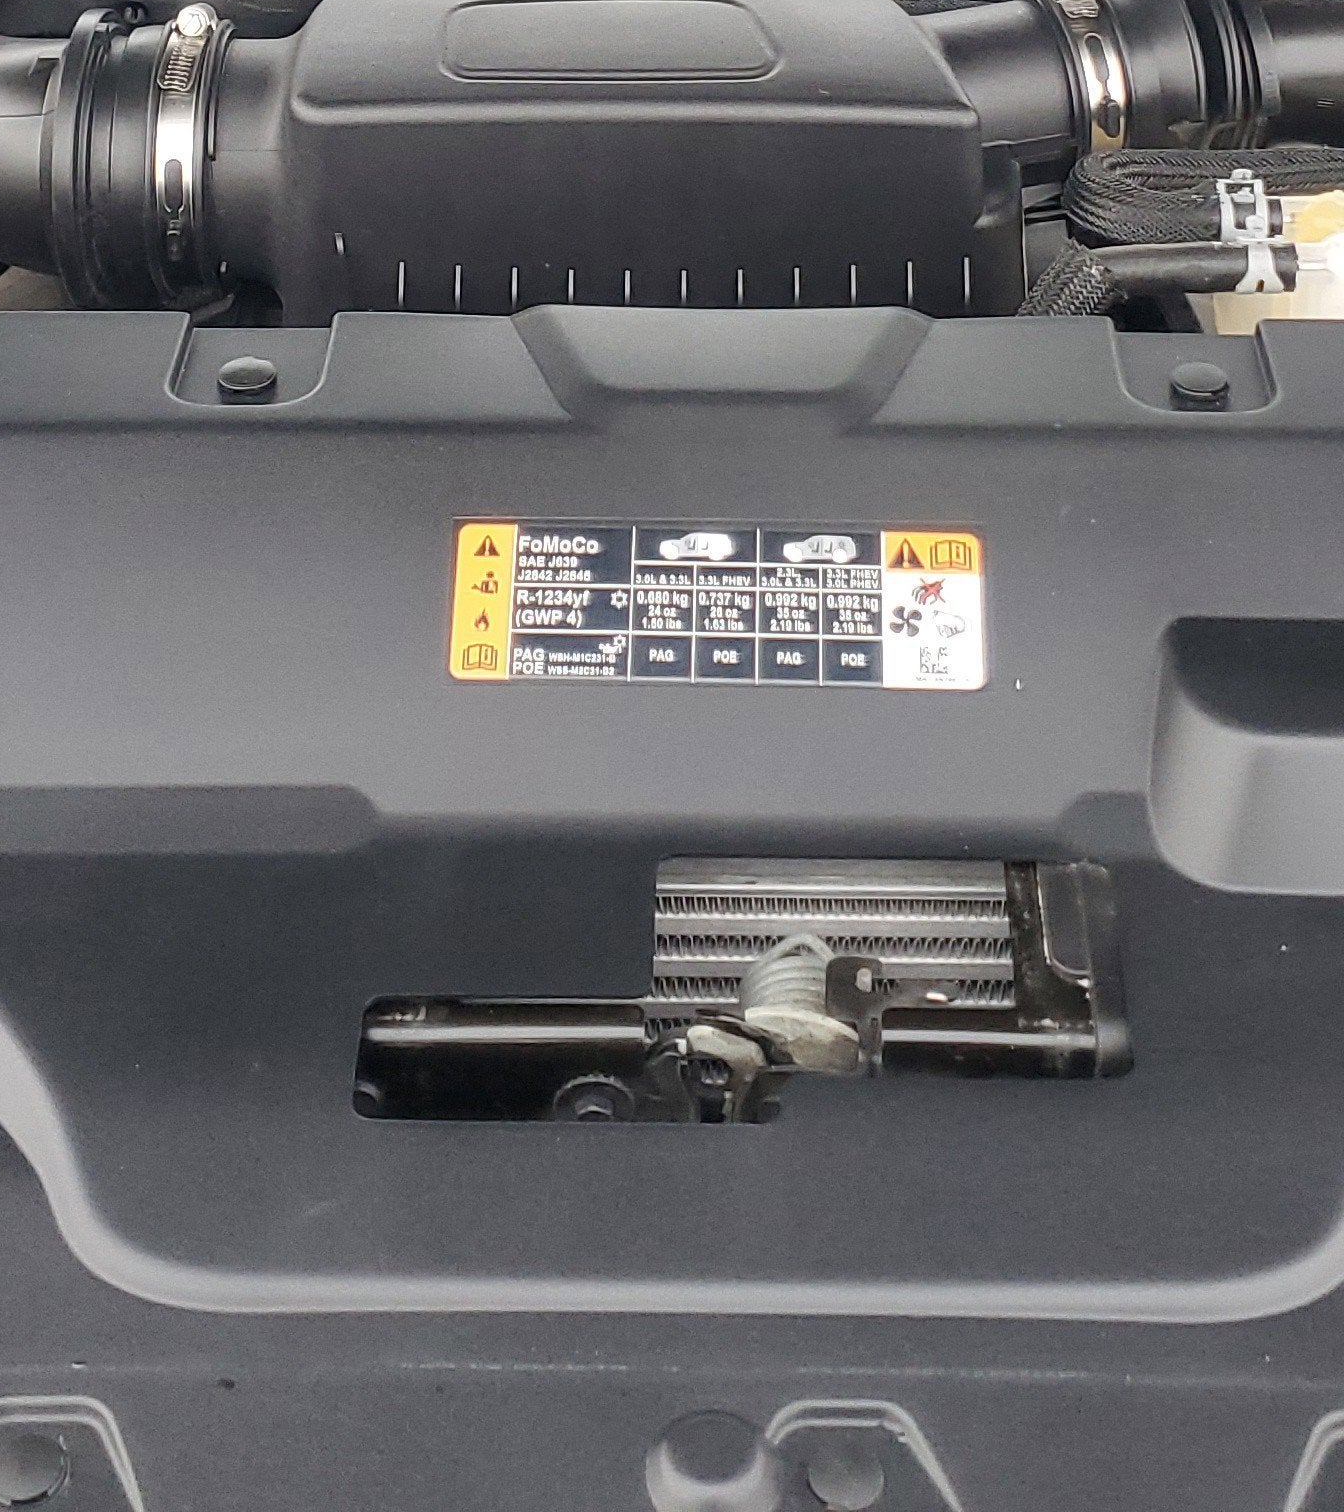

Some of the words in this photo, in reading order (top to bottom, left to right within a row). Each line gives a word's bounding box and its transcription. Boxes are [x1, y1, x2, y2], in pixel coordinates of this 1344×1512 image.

[518, 535, 600, 555] FoMoCo
[518, 555, 546, 568] SAE
[516, 589, 591, 609] R-1234yf
[672, 591, 690, 608] kg
[698, 591, 732, 606] 0.737
[734, 592, 751, 610] kg
[800, 593, 817, 610] kg
[862, 595, 879, 613] kg
[515, 609, 563, 627] (GWP
[566, 609, 582, 628] 4)
[513, 647, 545, 661] PAG
[649, 648, 675, 662] PAG
[776, 651, 803, 665] PAG
[512, 661, 544, 675] POE
